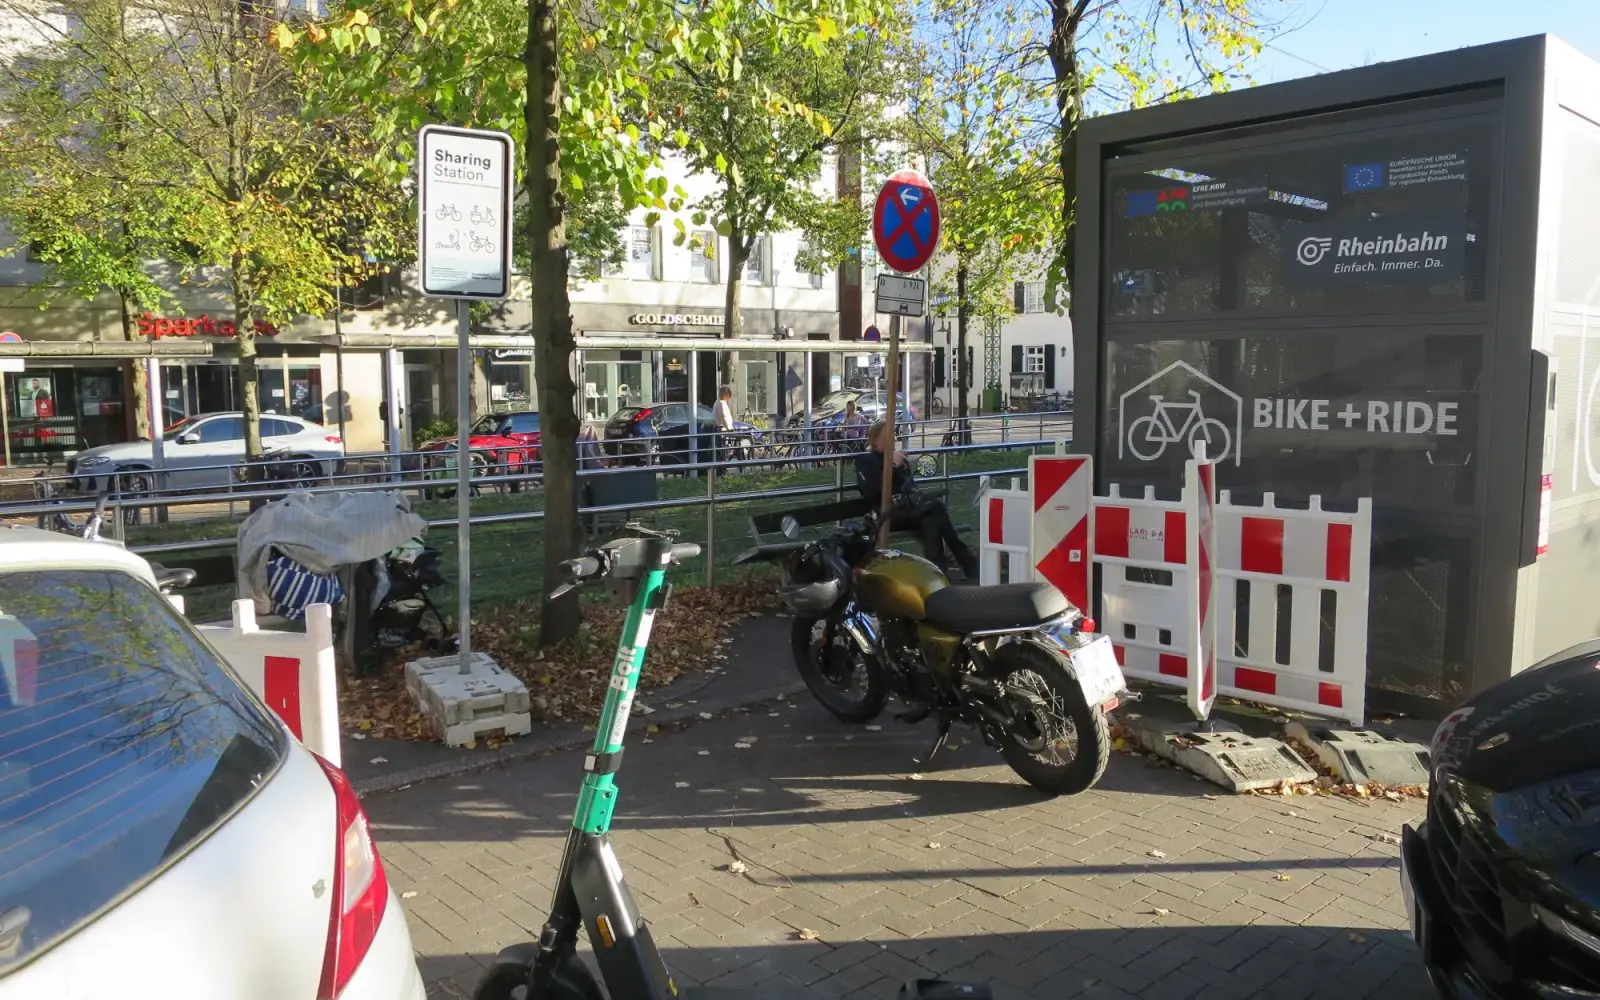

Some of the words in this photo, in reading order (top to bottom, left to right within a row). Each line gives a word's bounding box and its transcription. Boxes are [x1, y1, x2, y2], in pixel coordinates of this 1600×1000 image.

[435, 149, 491, 170] Sharing
[1390, 158, 1434, 167] EUROPÄISCHE
[1435, 154, 1457, 162] UNION
[434, 163, 484, 181] Station
[1429, 168, 1449, 176] Fonds
[1337, 231, 1448, 256] Rheinbahn
[1334, 262, 1377, 273] Einfach.
[1381, 260, 1420, 271] Immer.
[1424, 257, 1444, 268] Da.
[1253, 398, 1329, 430] BIKE
[1337, 403, 1361, 427] +
[1367, 400, 1458, 435] RIDE
[610, 646, 636, 692] Bolt
